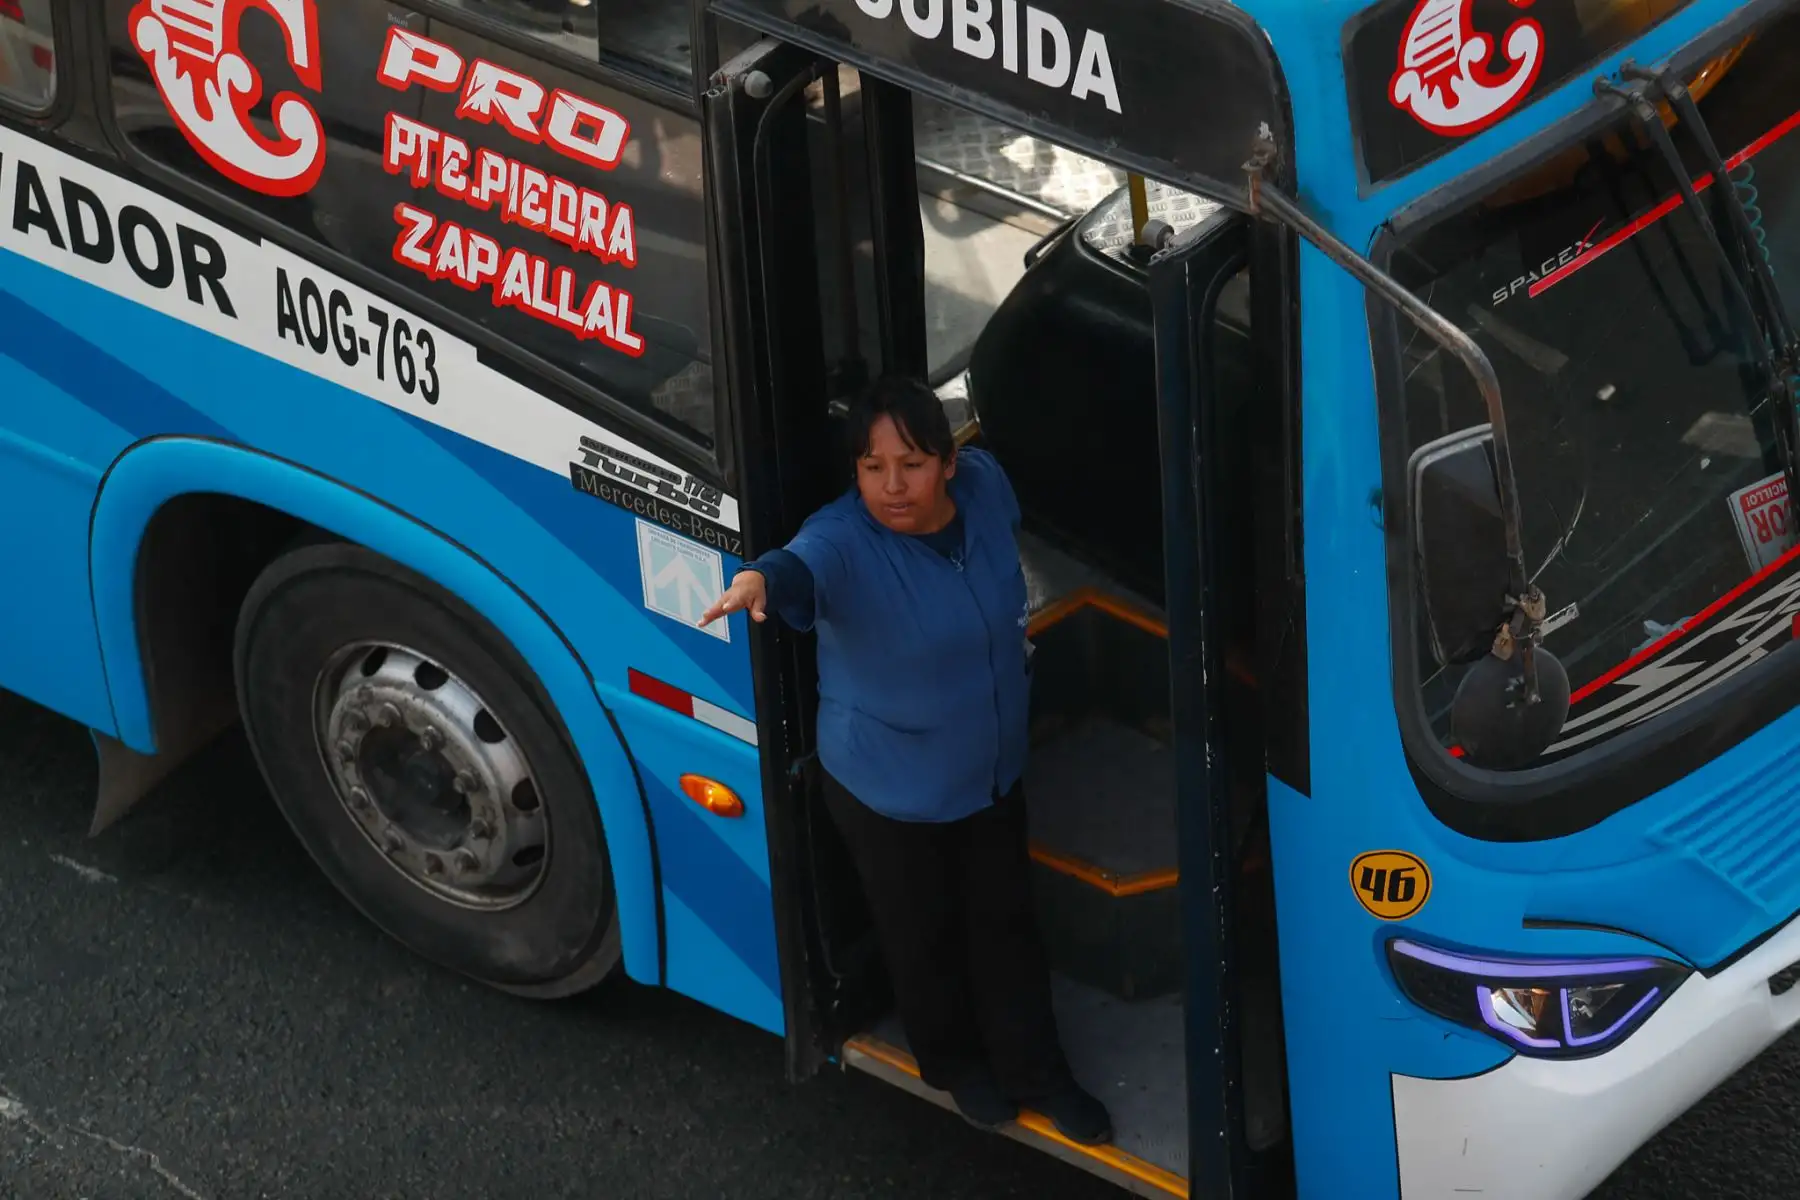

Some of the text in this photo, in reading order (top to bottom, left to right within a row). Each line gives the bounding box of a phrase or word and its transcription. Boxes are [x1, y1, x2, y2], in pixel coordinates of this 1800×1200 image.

[380, 27, 629, 167] PRO
[853, 0, 1122, 114] UBIDA
[0, 152, 238, 318] ADOR
[399, 205, 643, 352] ZAPALLAL
[1493, 219, 1602, 307] SPACEX
[276, 267, 440, 406] AOG-763
[575, 467, 743, 556] Mercedes-Benz
[577, 447, 721, 519] Turbo
[1360, 867, 1417, 903] 46
